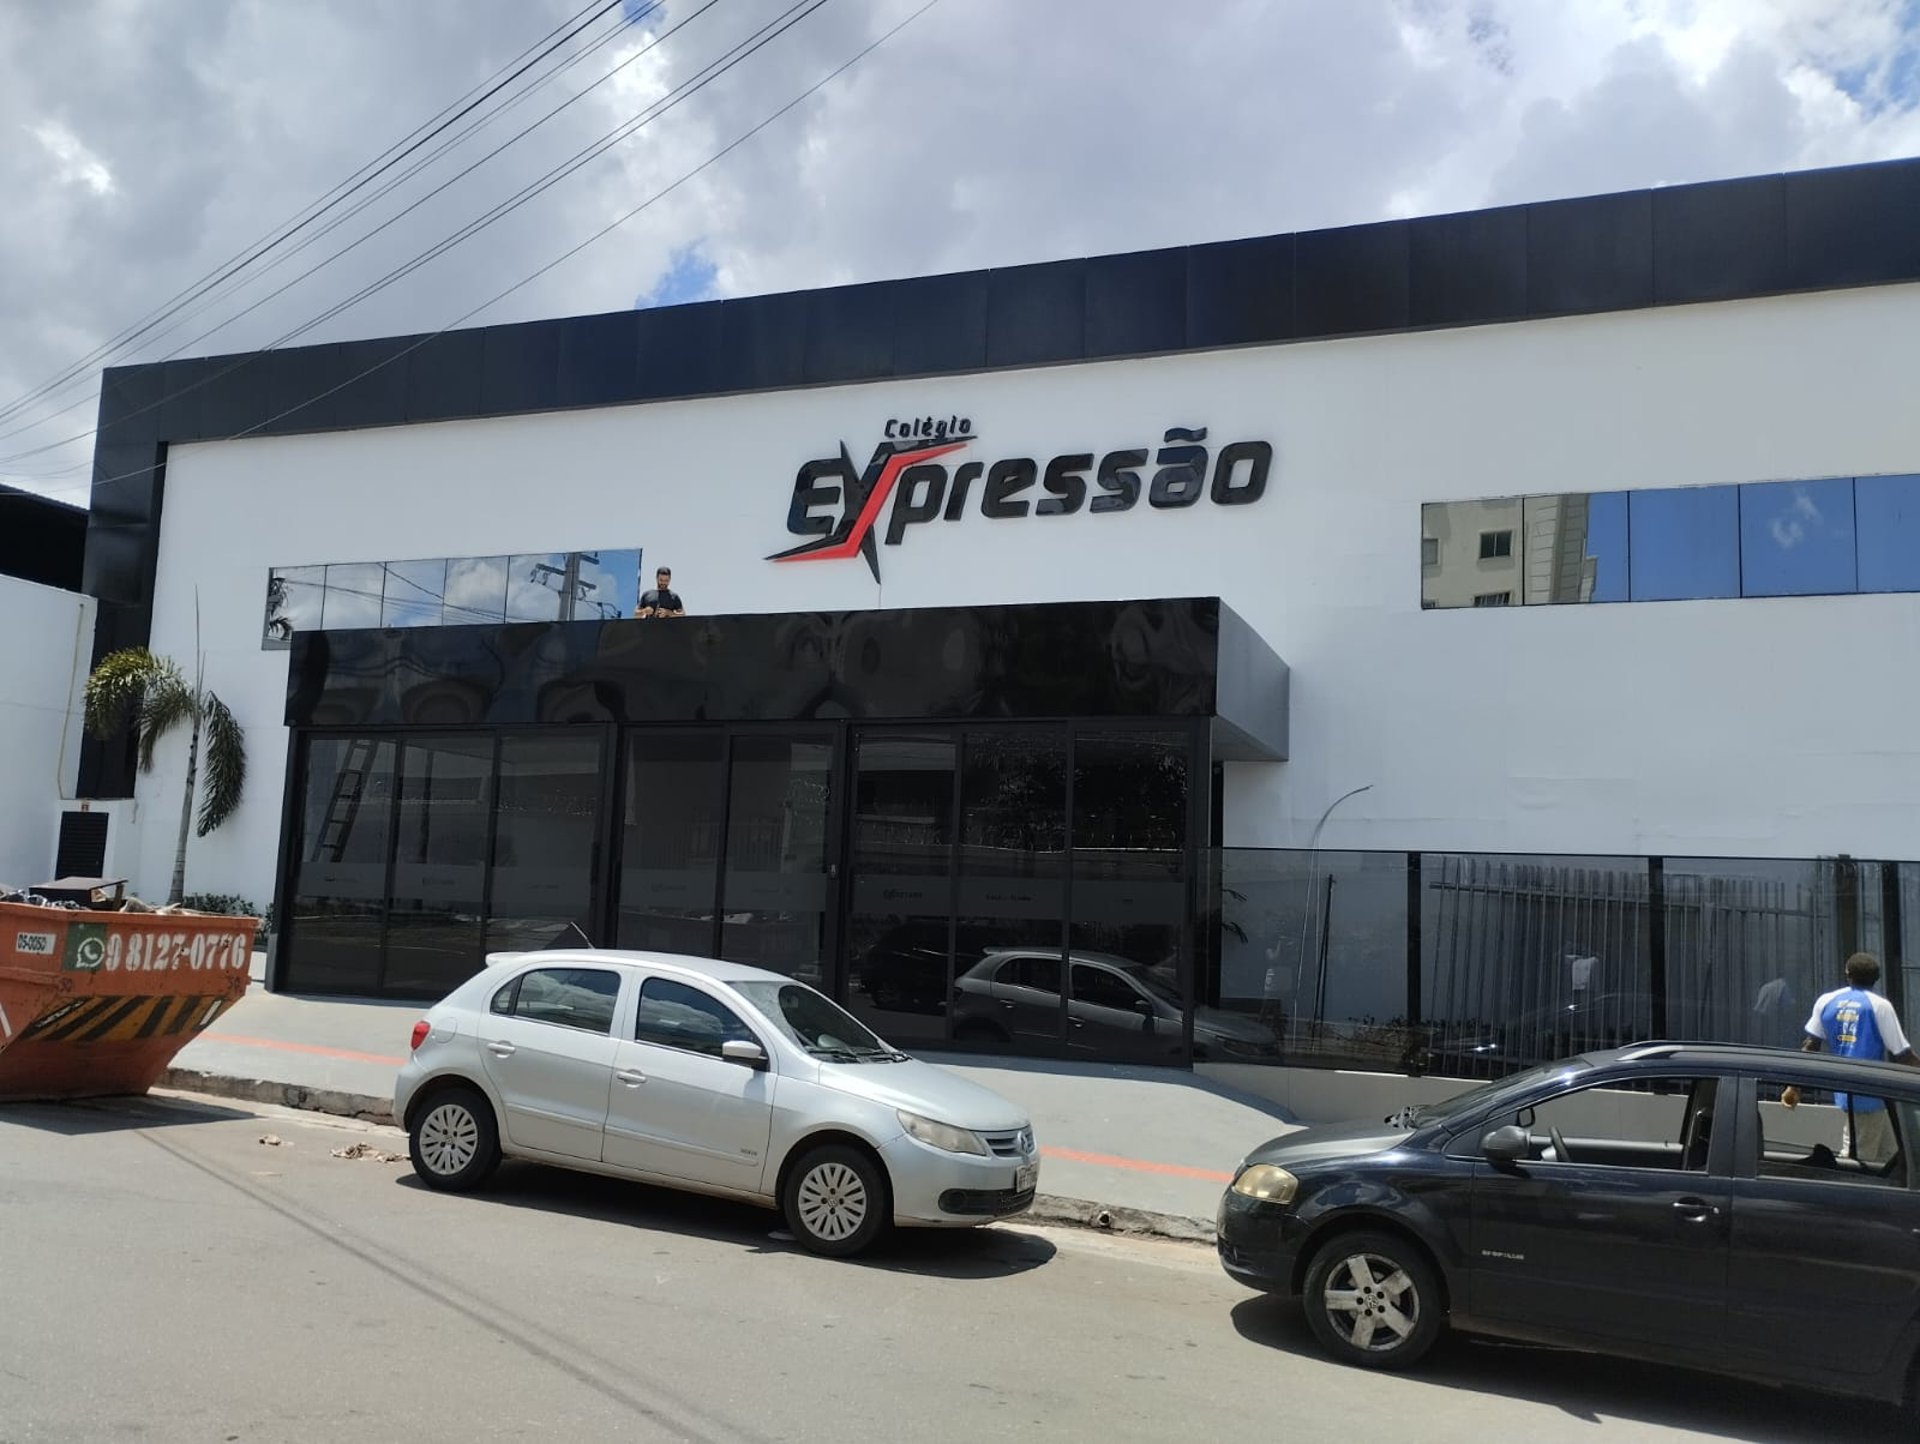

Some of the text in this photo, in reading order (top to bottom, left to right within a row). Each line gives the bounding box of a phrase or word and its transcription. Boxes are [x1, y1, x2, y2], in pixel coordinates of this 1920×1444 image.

[884, 414, 971, 439] Colégio
[105, 933, 246, 971] 9 8127-0776
